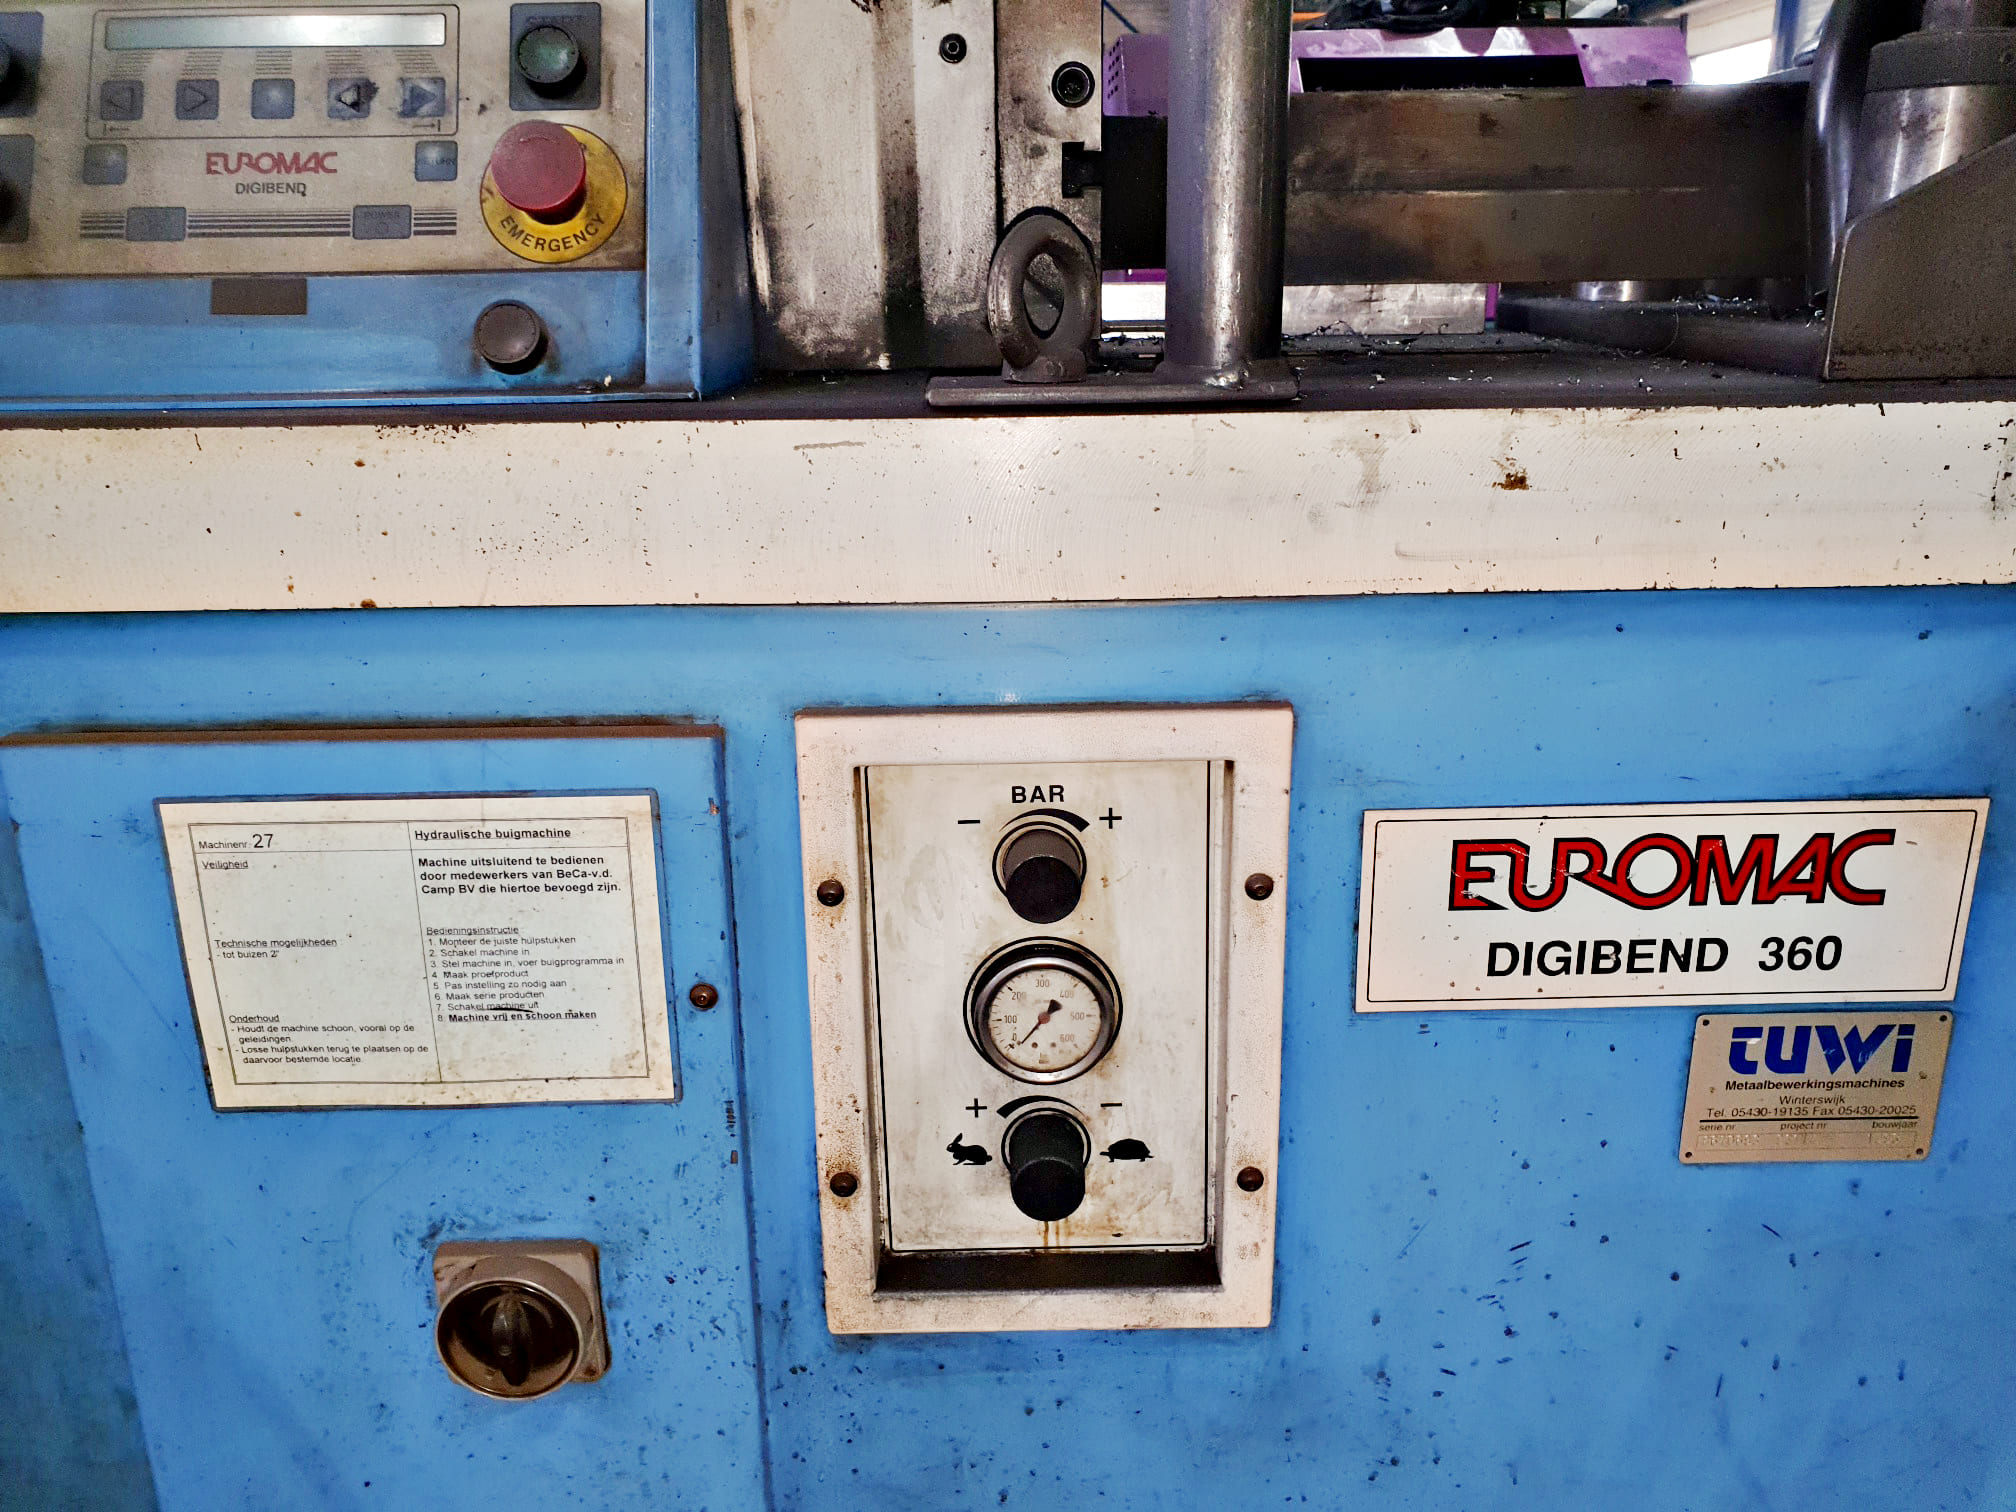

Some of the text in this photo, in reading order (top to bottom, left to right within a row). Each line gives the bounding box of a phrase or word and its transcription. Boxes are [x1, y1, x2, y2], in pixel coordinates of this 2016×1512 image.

[206, 151, 338, 175] EUROMAC
[235, 182, 307, 195] DIGIBEND
[500, 214, 605, 252] EMERGENCY
[1011, 785, 1066, 803] BAR
[415, 829, 572, 841] Hydraulische buigmachine
[252, 833, 274, 849] 27
[202, 860, 249, 870] Veiligheid
[418, 856, 604, 867] Machine uitsluitend te bedienen
[420, 871, 446, 880] door
[451, 870, 528, 880] medewerkers
[532, 871, 552, 879] van
[1448, 828, 1897, 912] EUROMAC
[421, 883, 621, 896] Camp BV die hiertoe bevoegd zijn.
[215, 939, 268, 948] Technische
[439, 937, 476, 946] Monteer
[480, 937, 491, 945] de
[494, 937, 518, 946] juiste
[521, 936, 576, 946] hulpstukken
[222, 951, 235, 959] tot
[237, 950, 268, 959] buizen
[440, 948, 477, 957] Schakel
[480, 948, 519, 956] machine
[521, 948, 530, 956] in
[1486, 934, 1842, 977] DIGIBEND 360
[441, 959, 460, 968] Stel
[462, 959, 501, 967] machine
[540, 958, 613, 968] buigprogramma
[616, 956, 624, 964] in
[443, 970, 469, 978] Maak
[471, 970, 529, 980] proefproduct
[444, 981, 462, 990] Pas
[465, 980, 505, 990] instelling
[521, 980, 547, 989] nodig
[549, 979, 566, 988] aan
[1035, 978, 1050, 988] 300
[446, 992, 471, 1000] Maak
[473, 991, 496, 1000] serie
[499, 990, 544, 1001] producten
[1011, 991, 1027, 1001] 200
[447, 1002, 484, 1011] Schakel
[486, 1002, 525, 1010] machine
[527, 1001, 539, 1009] uit
[229, 1014, 280, 1024] Onderhoud
[449, 1013, 490, 1023] Machine
[493, 1013, 508, 1022] vrij
[510, 1013, 523, 1021] en
[525, 1012, 562, 1021] schoon
[565, 1011, 596, 1020] maken
[1004, 1015, 1018, 1024] 100
[266, 1024, 279, 1033] de
[281, 1024, 319, 1032] machine
[359, 1024, 387, 1032] vooral
[389, 1024, 401, 1034] op
[403, 1024, 415, 1032] de
[241, 1045, 269, 1054] Losse
[271, 1045, 325, 1055] hulpstukken
[327, 1044, 350, 1055] terug
[351, 1045, 361, 1053] te
[363, 1044, 401, 1055] plaatsen
[403, 1045, 415, 1054] op
[417, 1044, 429, 1053] de
[243, 1055, 282, 1064] daarvoor
[285, 1055, 329, 1064] bestemde
[1725, 1078, 1905, 1091] Metaalbewerkingsmachines
[1779, 1094, 1846, 1105] Winterswijk
[1706, 1105, 1917, 1118] Tel. 05430-19135 Fax 05430-20025
[1699, 1123, 1736, 1132] serie nr
[1780, 1120, 1827, 1131] project nr
[1871, 1119, 1918, 1130] bouwjaar
